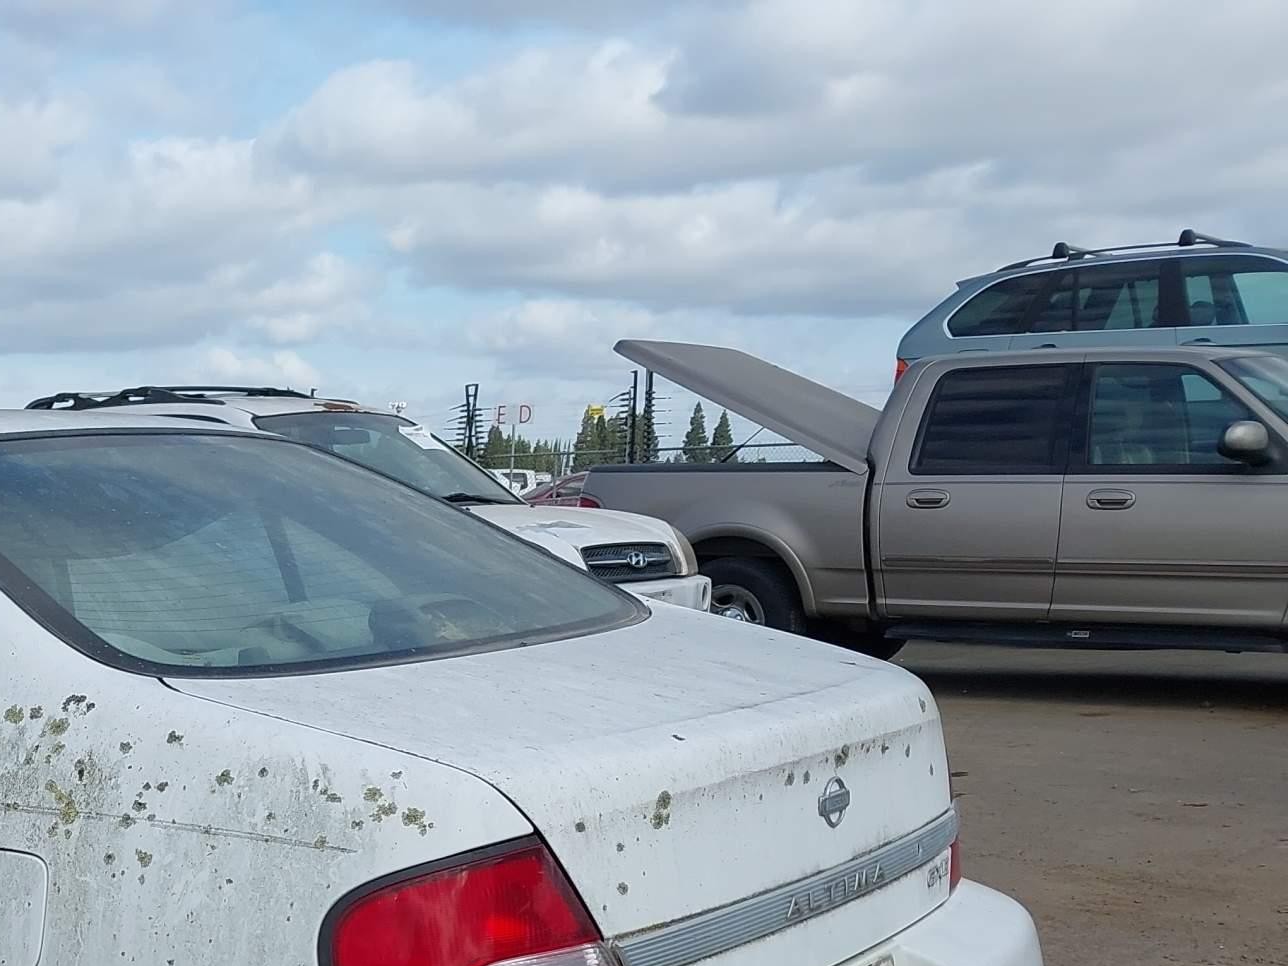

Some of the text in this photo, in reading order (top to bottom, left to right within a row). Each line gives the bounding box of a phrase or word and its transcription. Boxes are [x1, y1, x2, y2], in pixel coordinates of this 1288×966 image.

[497, 405, 507, 424] E
[519, 404, 532, 424] D
[786, 863, 885, 918] ALTIMA
